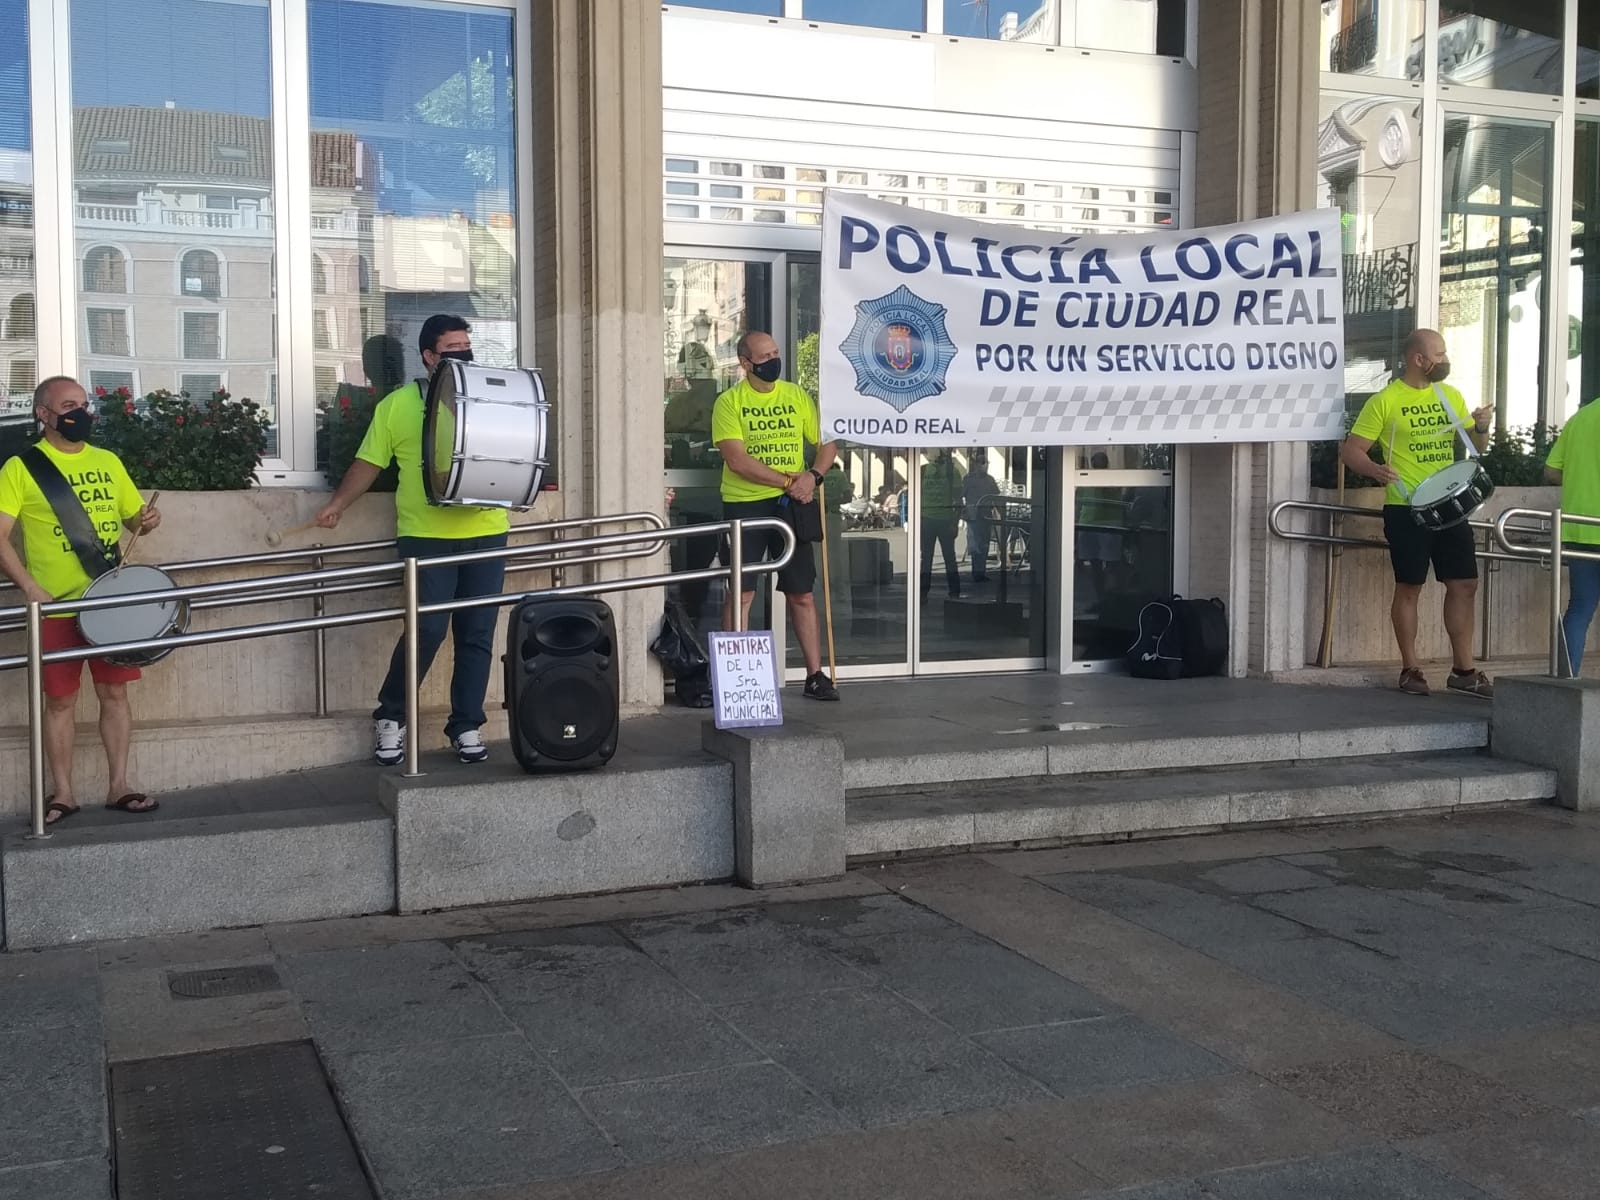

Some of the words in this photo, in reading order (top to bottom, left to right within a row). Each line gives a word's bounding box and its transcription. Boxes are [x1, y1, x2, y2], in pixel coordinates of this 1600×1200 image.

[838, 215, 1120, 285] POLICÍA
[1140, 229, 1339, 283] LOCAL
[980, 289, 1040, 328] DE
[1055, 290, 1219, 328] CIUDAD
[1233, 288, 1338, 325] REAL
[904, 313, 930, 335] LOCAL
[976, 343, 1036, 372] POR
[1045, 344, 1086, 372] UN
[1096, 342, 1236, 373] SERVICIO
[1246, 340, 1338, 370] DIGNO
[749, 418, 795, 431] LOCAL
[833, 417, 908, 436] CIUDAD
[914, 416, 966, 435] REAL
[1410, 414, 1453, 428] LOCAL
[748, 433, 778, 441] CIUDAD
[746, 443, 798, 455] CONFLICTO
[1408, 440, 1452, 452] CONFLICT
[759, 456, 796, 466] ABORAL
[79, 487, 114, 503] CAL
[717, 638, 770, 655] MENTIRAS
[726, 659, 742, 673] DE
[748, 659, 764, 671] LA
[723, 689, 775, 704] PORTAVOZ
[724, 703, 777, 719] MUNICIPAL
